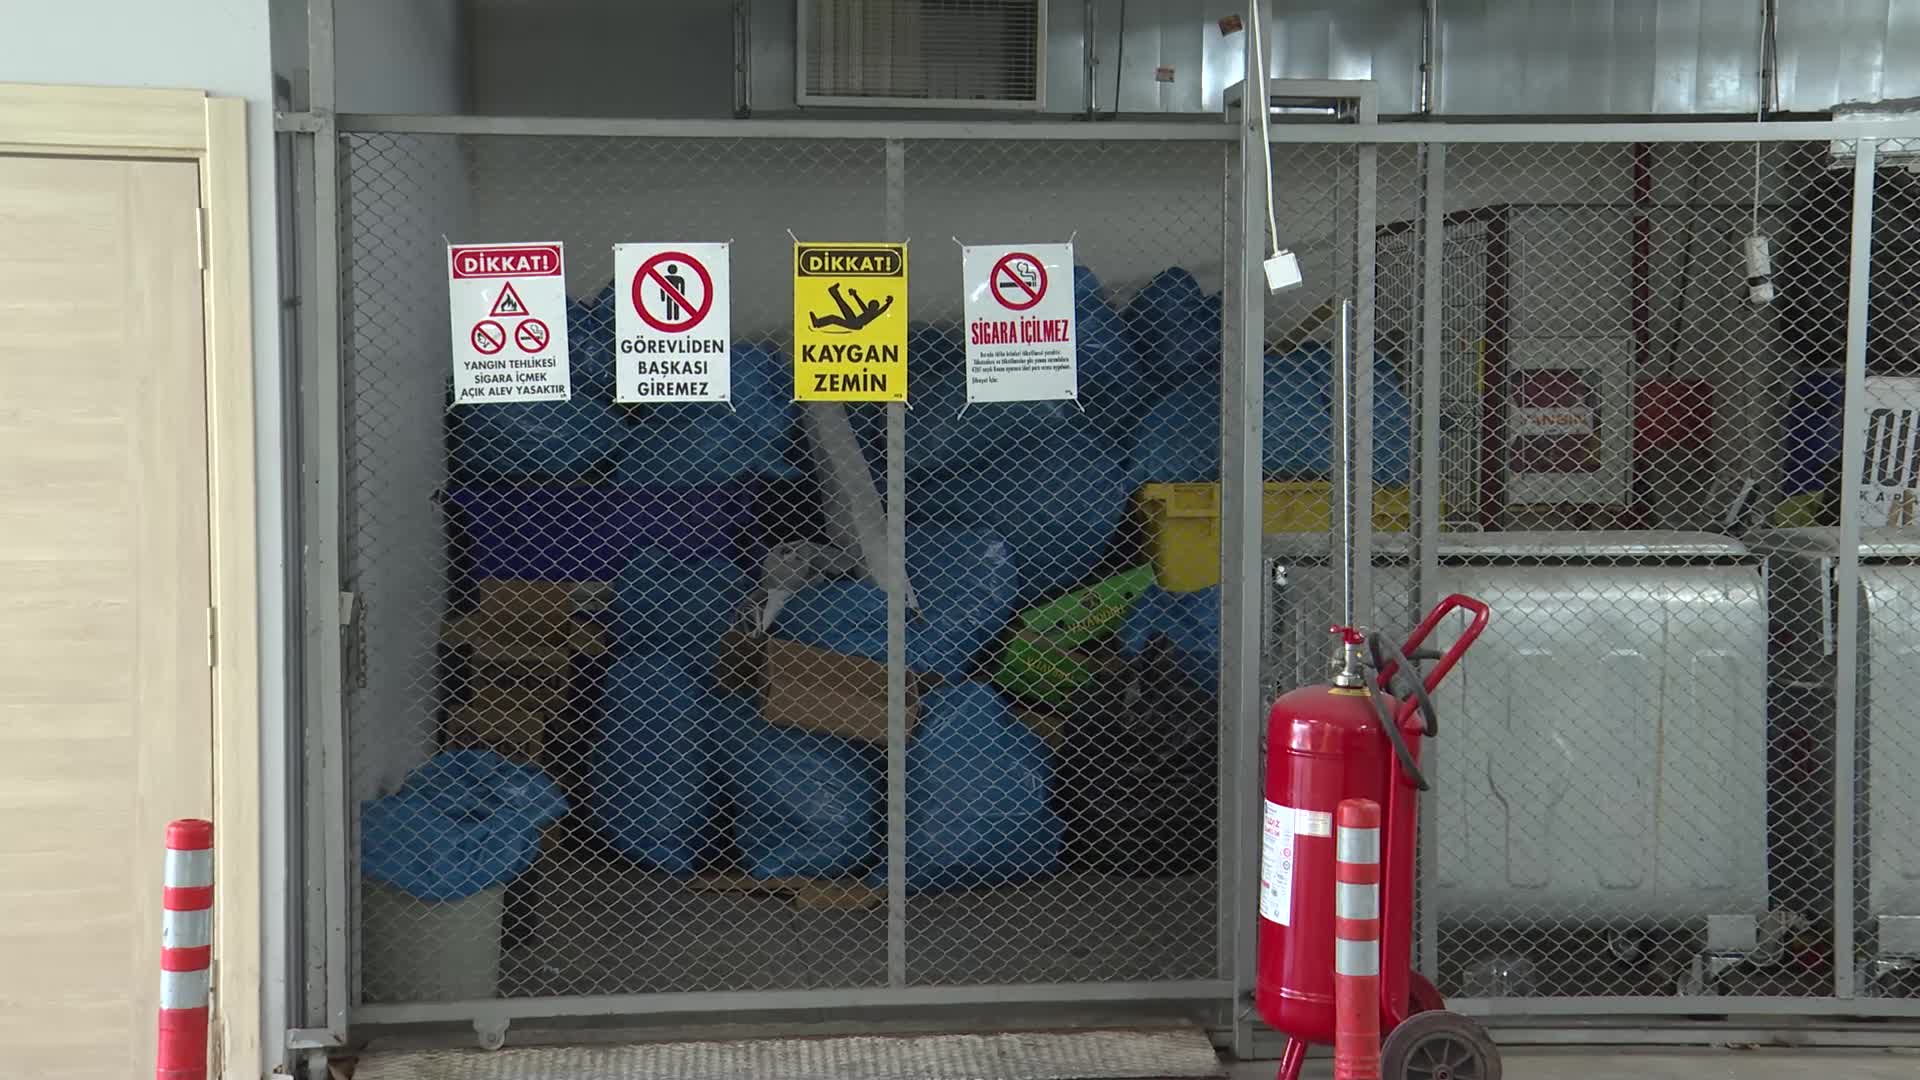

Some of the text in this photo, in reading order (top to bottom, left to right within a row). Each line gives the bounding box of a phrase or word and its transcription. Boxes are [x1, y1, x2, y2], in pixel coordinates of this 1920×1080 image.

[464, 253, 549, 273] DİKKAT!
[809, 252, 892, 271] DİKKAT!
[971, 315, 1069, 346] SİGARA İÇİLMEZ
[621, 335, 724, 354] GÖREVLİDEN
[802, 344, 898, 363] KAYGAN
[464, 357, 556, 371] YANGIN TEHLİKESİ
[638, 360, 708, 380] BAŞKASI
[474, 370, 547, 385] SİGARA İÇMEK
[638, 378, 708, 396] GİREMEZ
[814, 367, 887, 392] ZEMİN
[461, 384, 565, 399] AÇIK ALEV YASAKTIR
